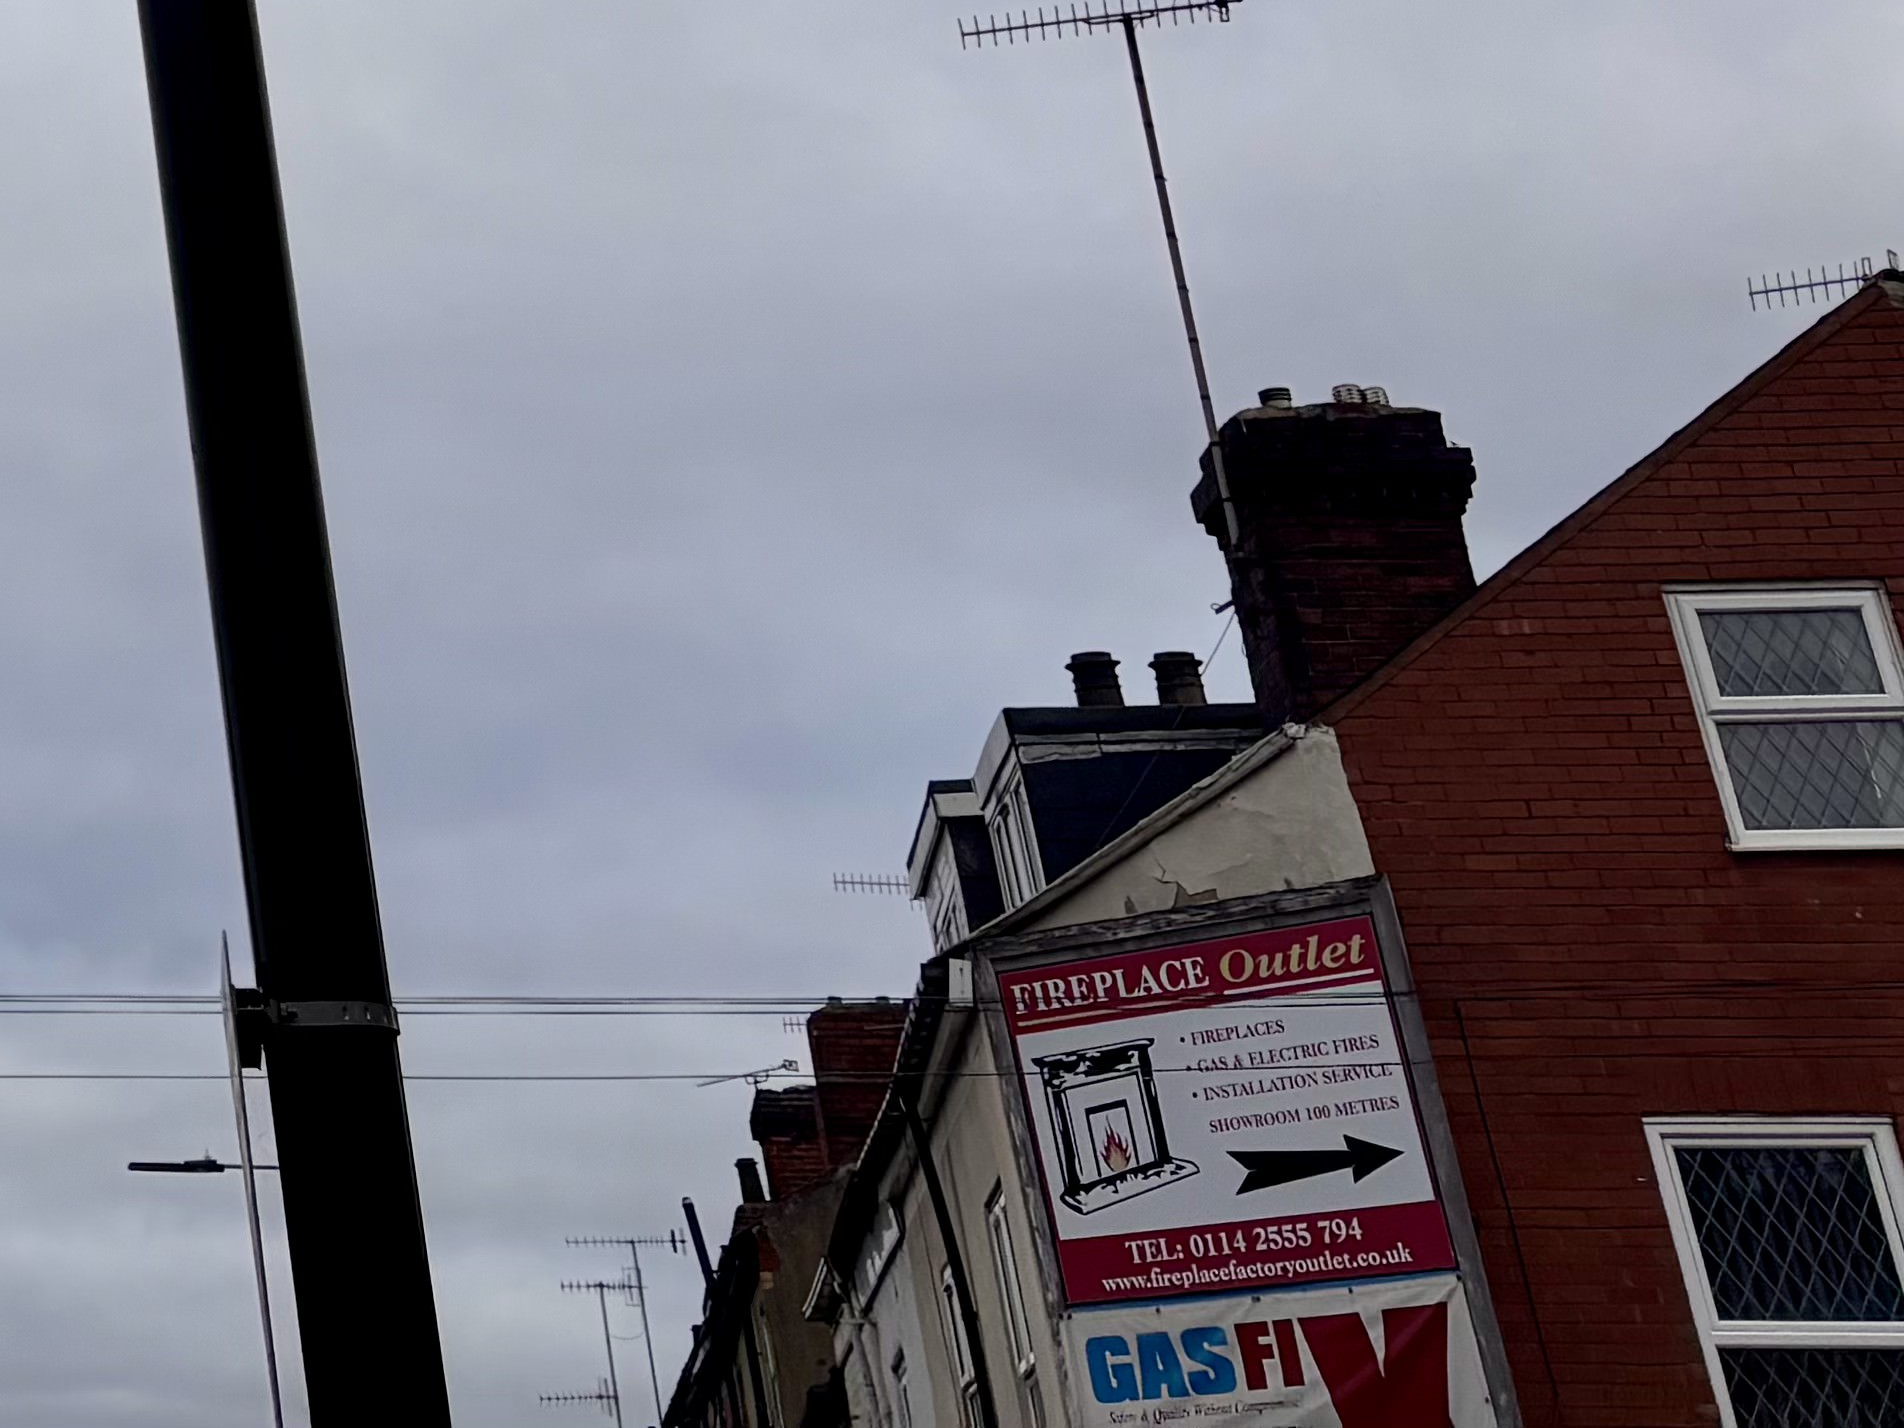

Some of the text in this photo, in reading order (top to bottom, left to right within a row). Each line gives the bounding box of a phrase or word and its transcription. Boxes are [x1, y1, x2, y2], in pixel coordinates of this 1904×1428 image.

[1010, 934, 1366, 1015] FIREPLACE Outlet
[1191, 1019, 1285, 1046] FIREPLACES
[1197, 1055, 1229, 1073] GAS
[1248, 1041, 1329, 1067] ELECTRIC
[1332, 1034, 1380, 1055] FIRES
[1203, 1063, 1393, 1101] INSTALLATION SERVICE
[1209, 1096, 1400, 1133] SHOWROOM 100 METRES
[1125, 1216, 1363, 1264] TEL: 0114 2555 794
[1102, 1242, 1413, 1292] www.fireplacefactoryoutlet.co.uk
